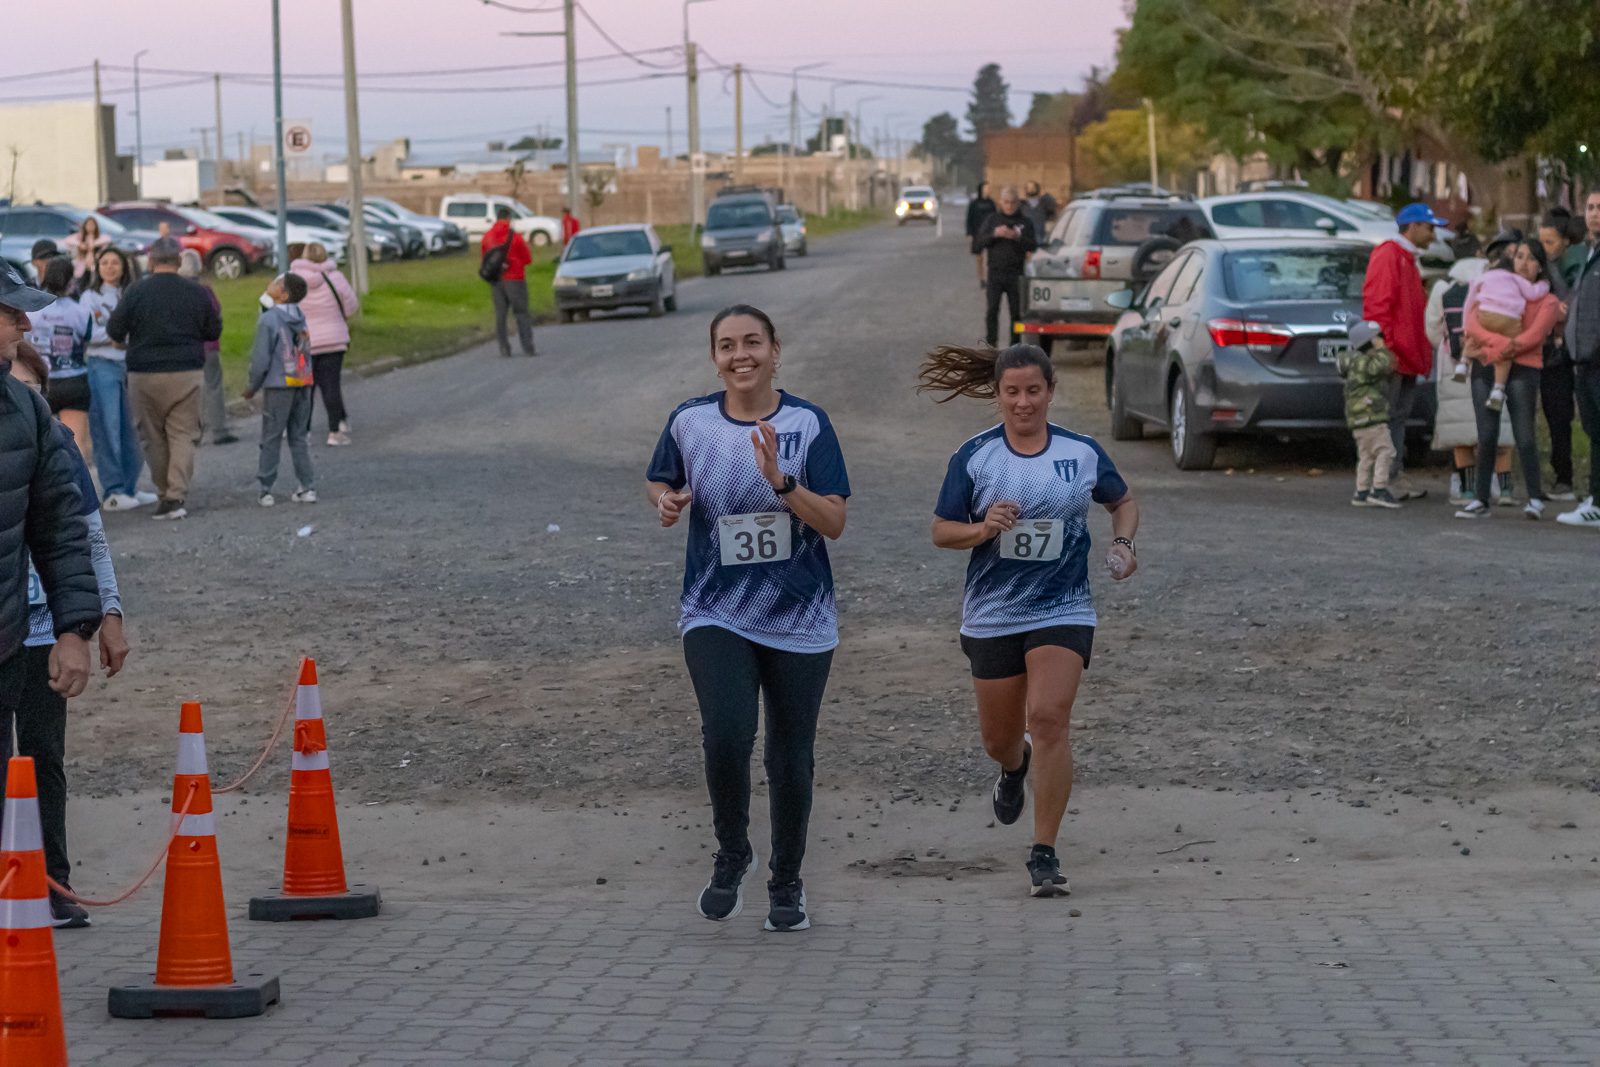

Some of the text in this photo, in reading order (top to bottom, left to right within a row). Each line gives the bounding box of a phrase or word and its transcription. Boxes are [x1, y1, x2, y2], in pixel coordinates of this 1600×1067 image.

[1032, 287, 1051, 302] 80
[779, 433, 797, 442] SFC
[1058, 460, 1074, 468] SFC
[734, 529, 777, 562] 36
[1014, 533, 1051, 559] 87
